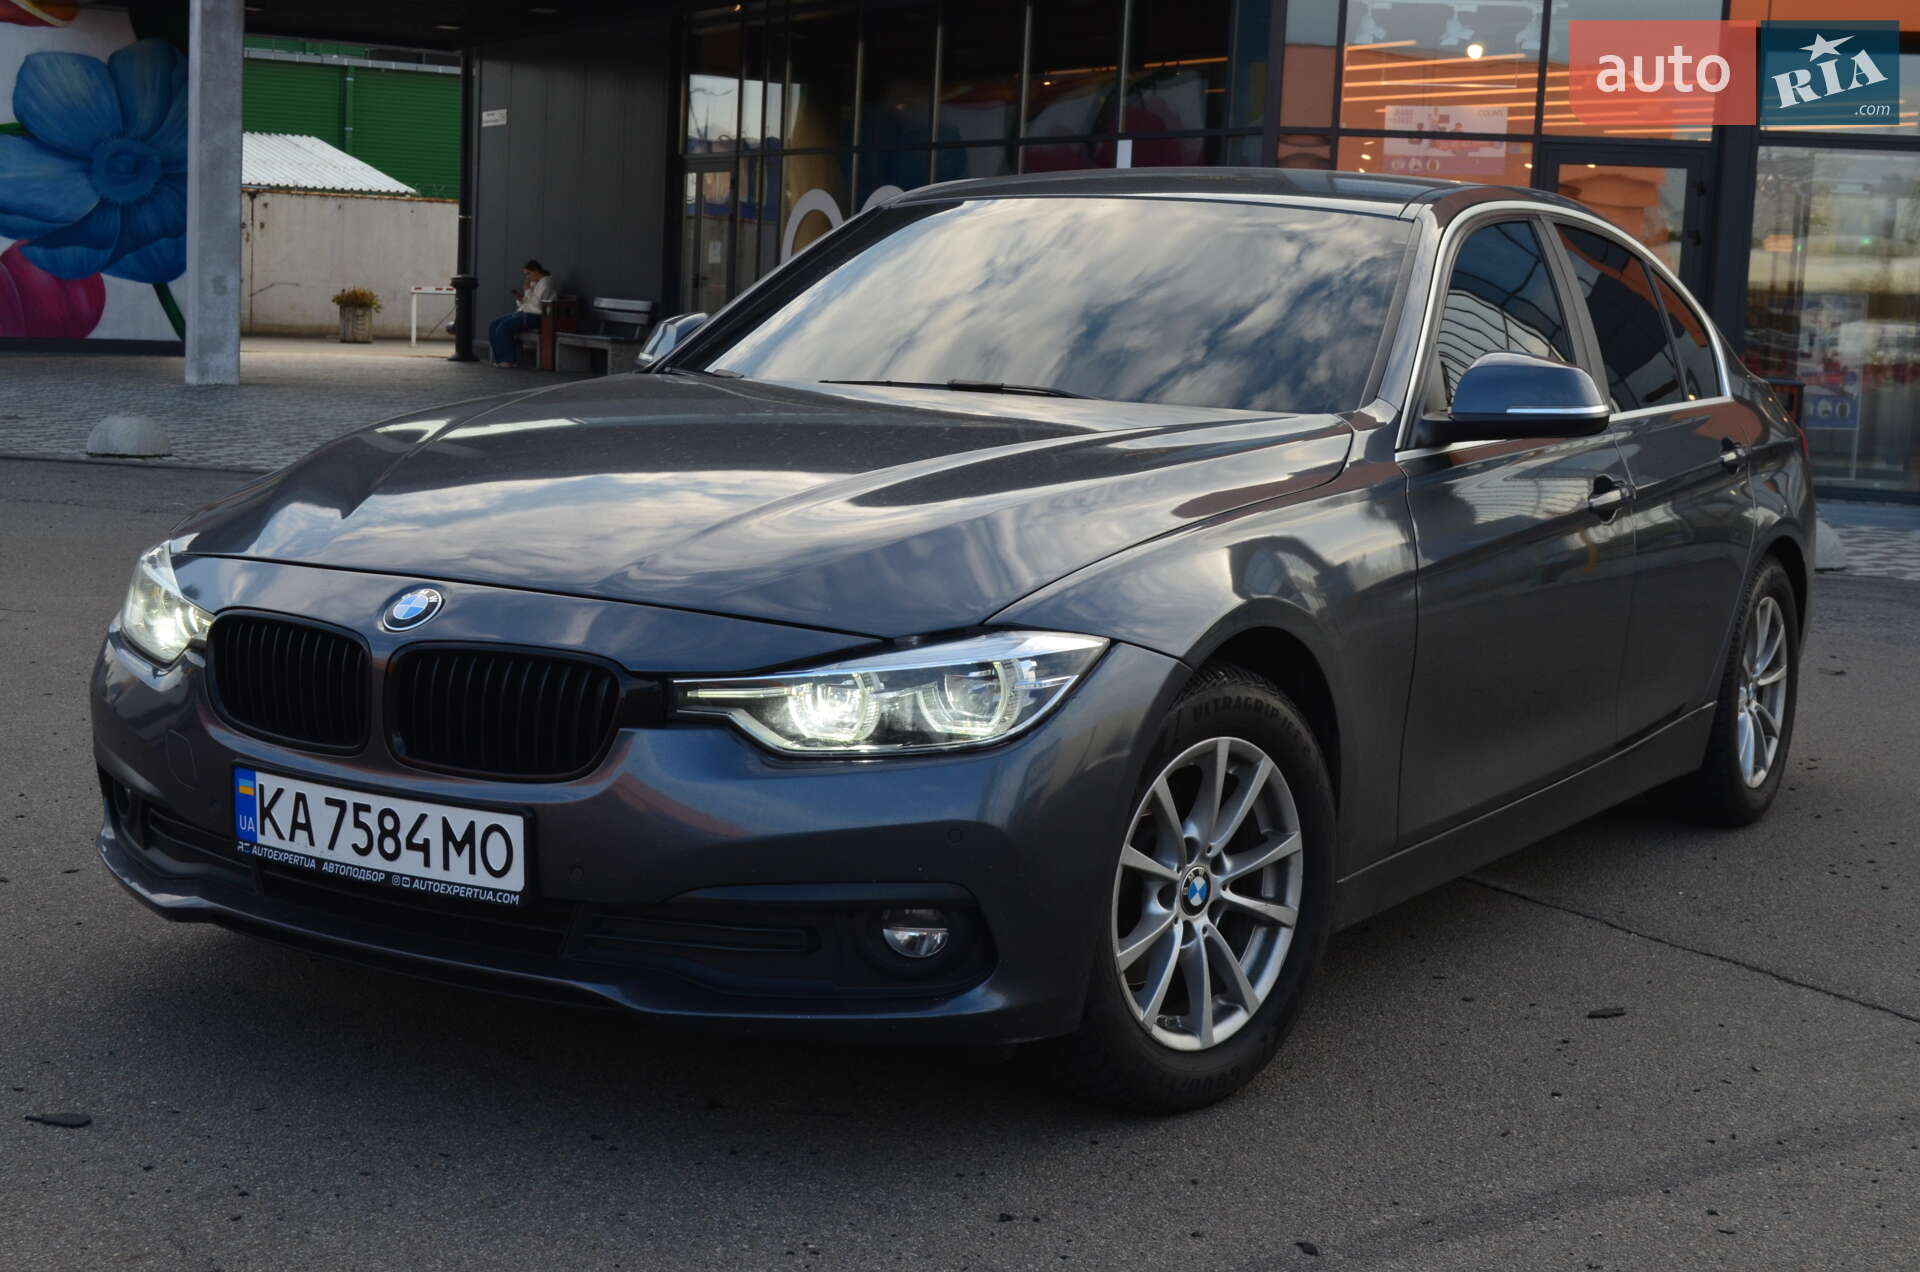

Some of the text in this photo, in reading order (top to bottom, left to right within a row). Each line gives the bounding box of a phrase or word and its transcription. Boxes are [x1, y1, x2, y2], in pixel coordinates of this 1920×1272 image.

[239, 814, 256, 833] UA
[251, 845, 317, 869] AUTOEXPERTUA
[321, 861, 386, 883] АВТОПОДБОР
[412, 878, 521, 905] AUTOEXPERTUA.COM
